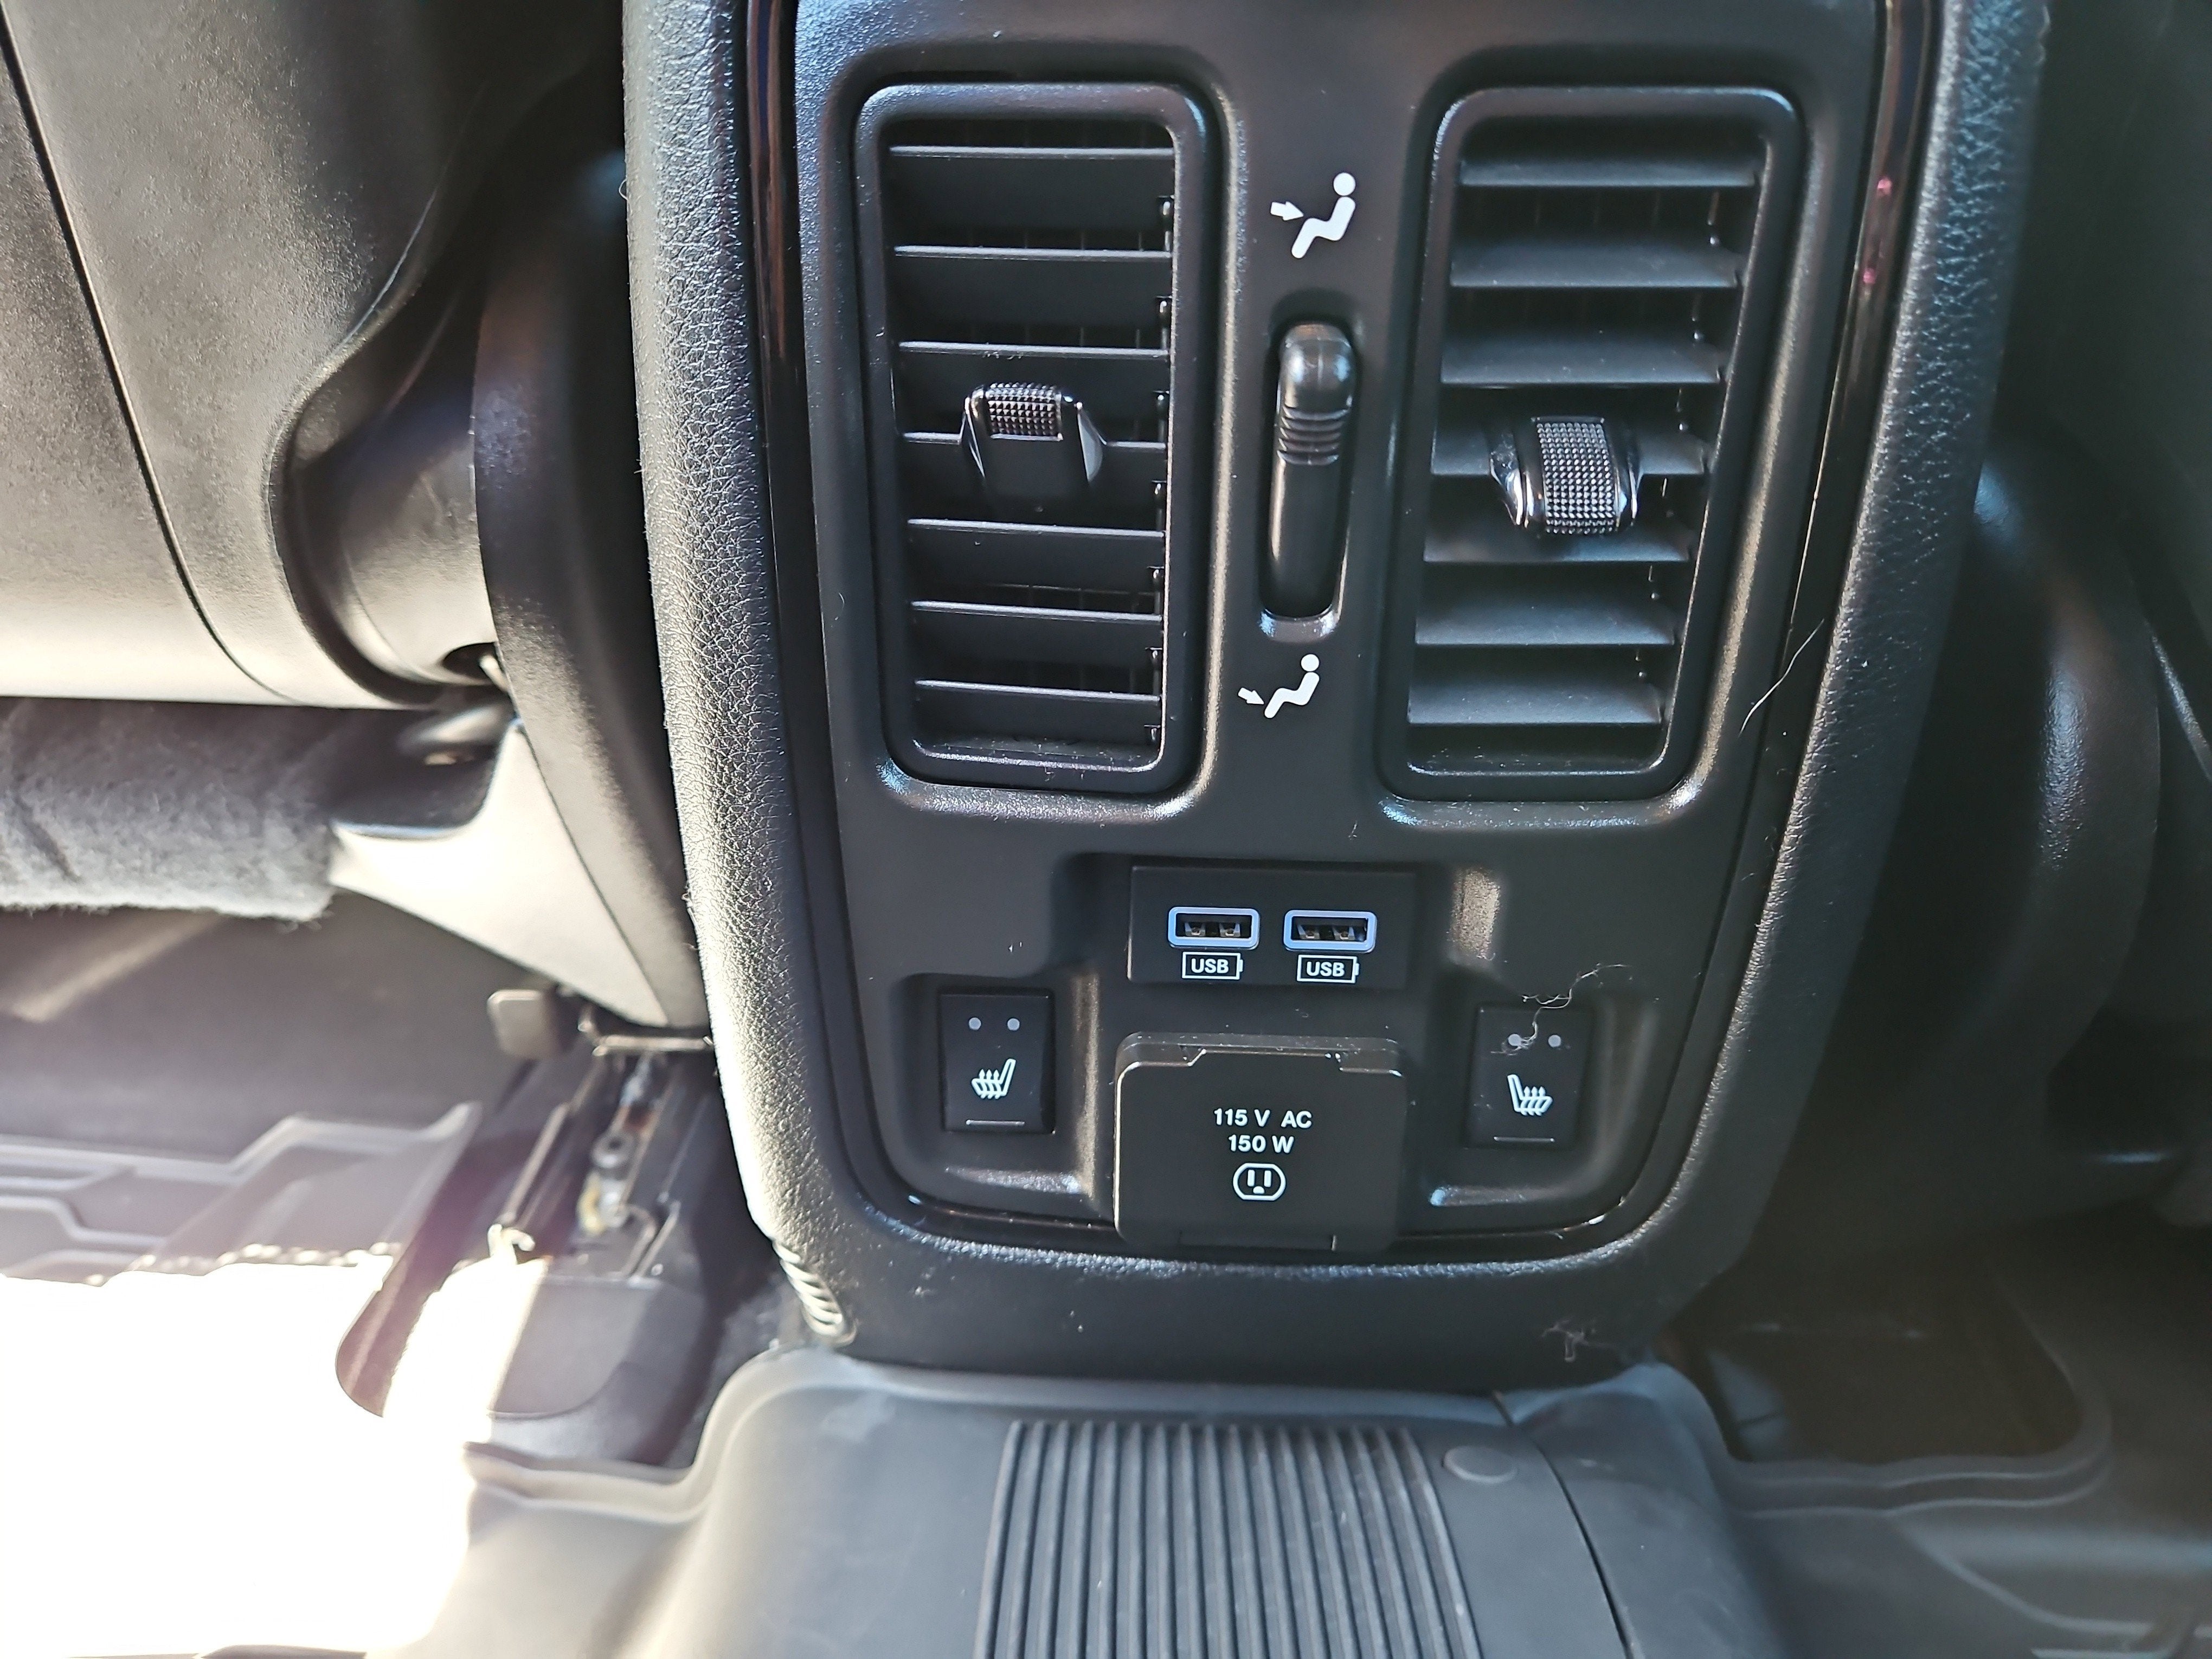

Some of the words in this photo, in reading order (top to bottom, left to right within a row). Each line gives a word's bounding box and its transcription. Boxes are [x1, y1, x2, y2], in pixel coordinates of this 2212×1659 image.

[1191, 958, 1229, 974] USB
[1306, 961, 1345, 978] USB
[1213, 1108, 1248, 1127] 115
[1254, 1109, 1271, 1127] V
[1280, 1110, 1313, 1129] AC
[1227, 1134, 1266, 1153] 150
[1271, 1135, 1295, 1154] W
